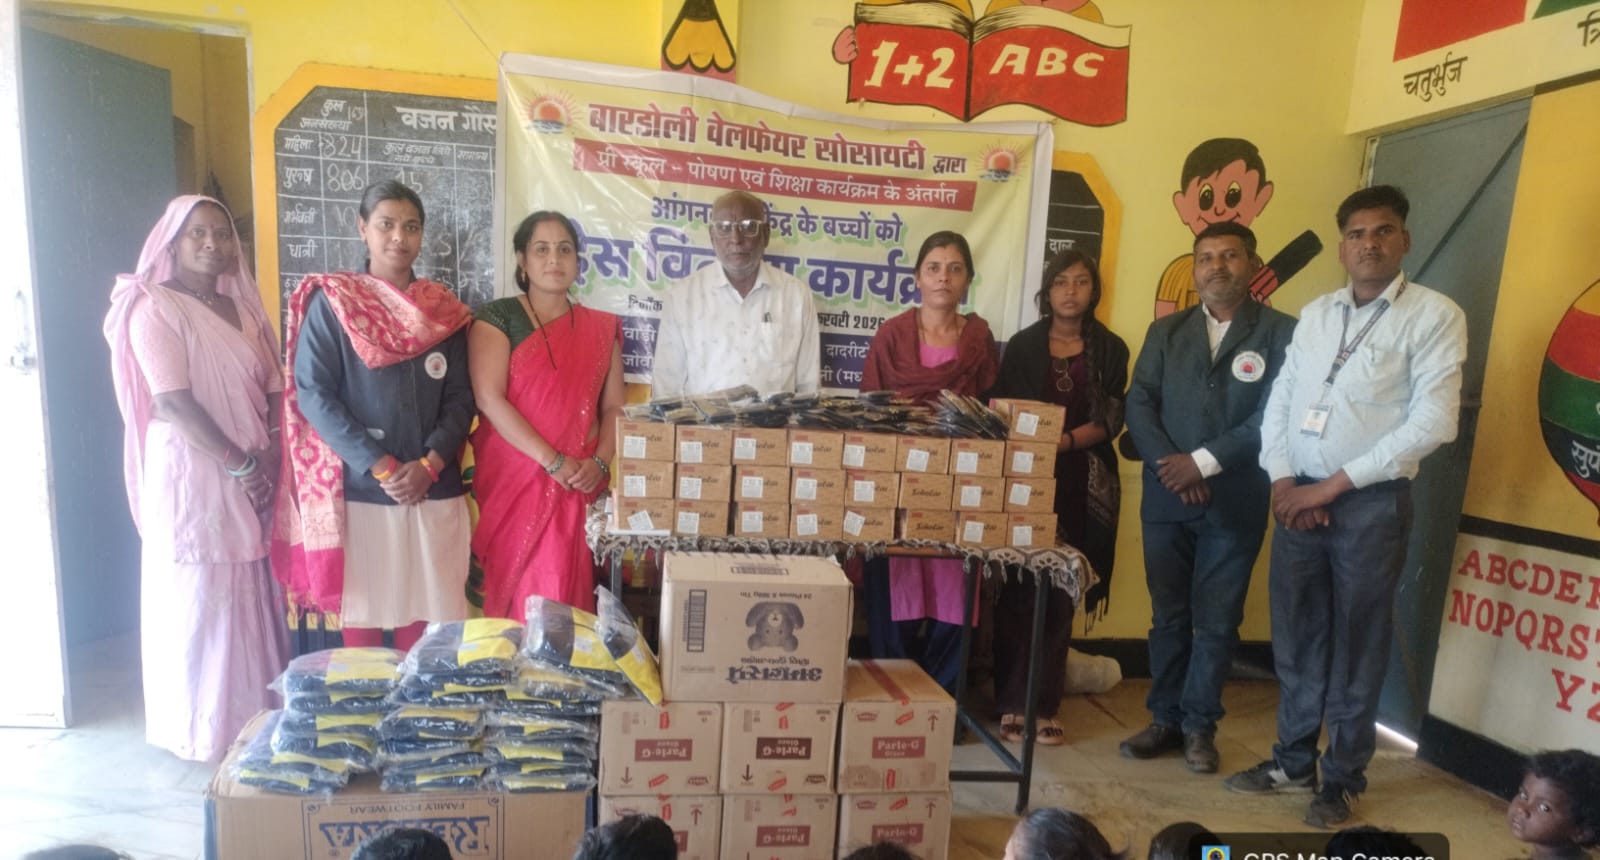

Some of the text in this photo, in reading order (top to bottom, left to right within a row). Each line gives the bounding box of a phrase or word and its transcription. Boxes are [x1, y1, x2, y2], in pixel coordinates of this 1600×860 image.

[864, 40, 955, 88] 1+2
[990, 44, 1104, 78] ABC
[1403, 51, 1468, 102] चतुर्भुज
[394, 106, 459, 131] वजन
[588, 103, 967, 175] बारडोली वेलफेयर सोसायटी द्वारा
[623, 153, 667, 178] स्कूल
[688, 155, 737, 184] पोषण
[739, 166, 766, 190] एवं
[768, 168, 813, 194] शिक्षा
[816, 174, 880, 201] कार्यक्रम
[883, 179, 901, 201] के
[905, 182, 959, 204] अंतर्गत
[797, 206, 819, 234] के
[821, 210, 872, 240] बच्चों
[875, 212, 903, 242] को
[825, 342, 870, 359] दादरीटो
[641, 748, 687, 758] Parle-G
[761, 746, 807, 757] Parle-G
[877, 740, 920, 750] Parle-G
